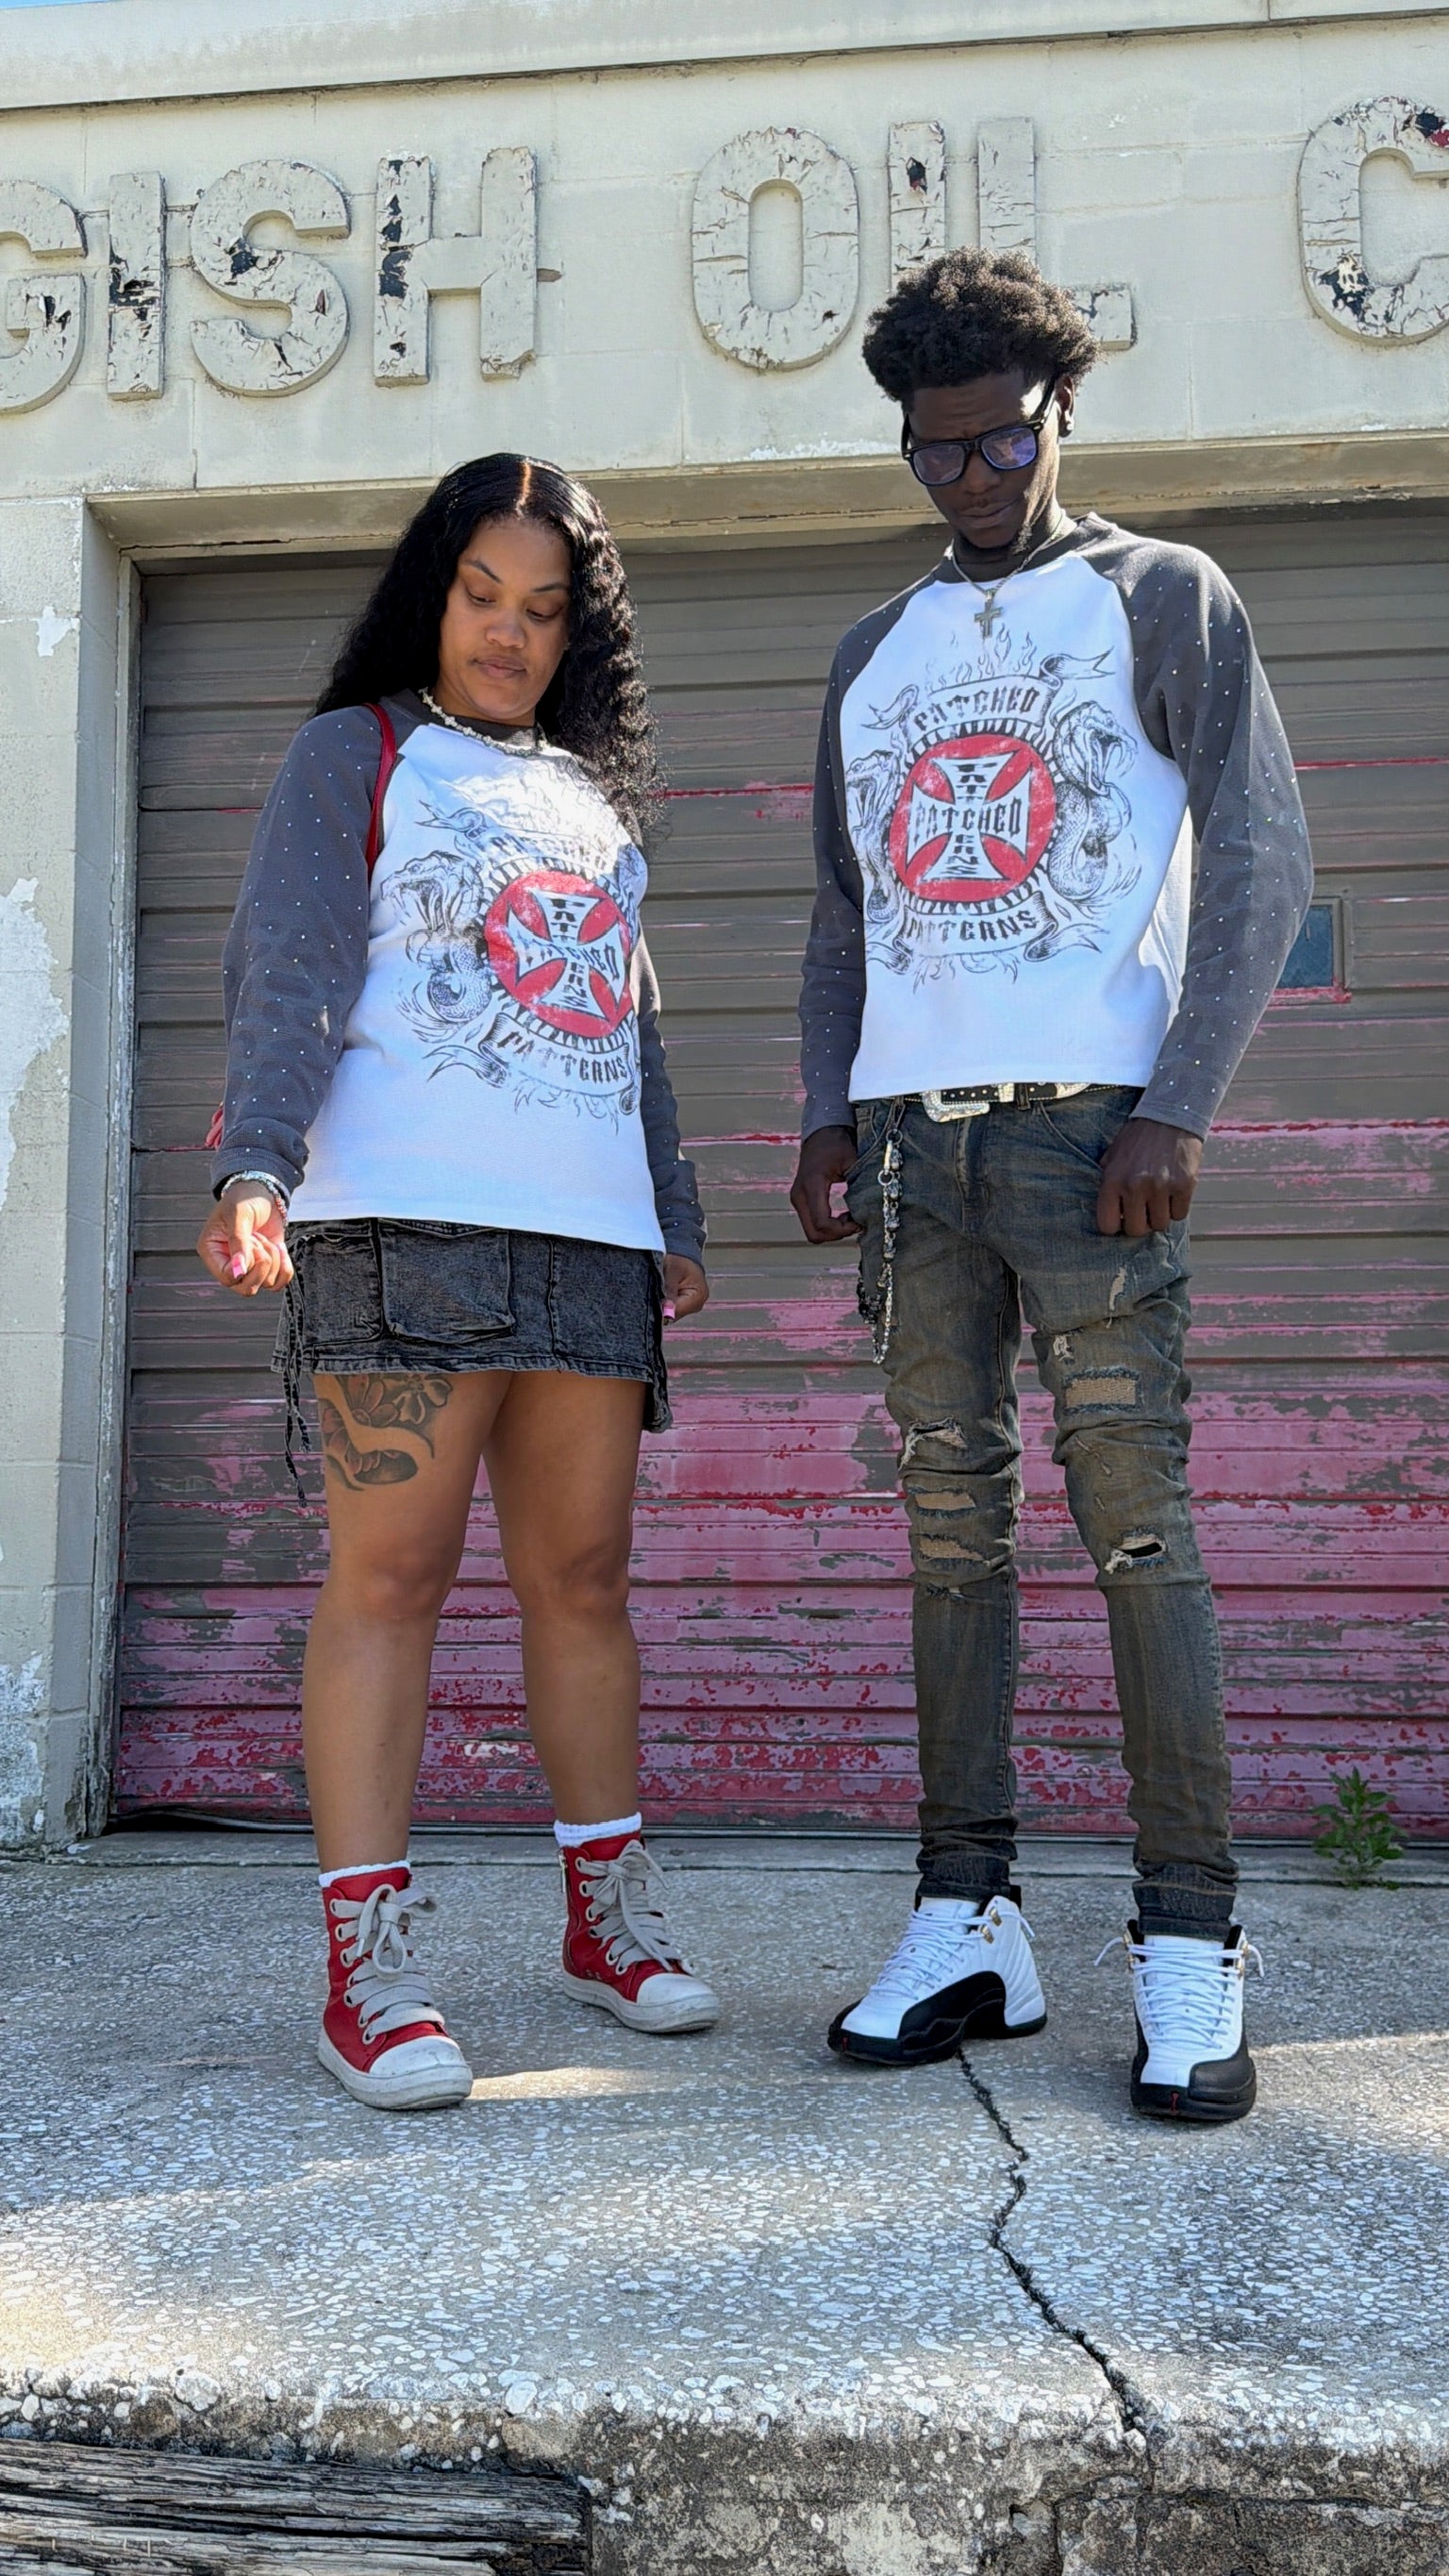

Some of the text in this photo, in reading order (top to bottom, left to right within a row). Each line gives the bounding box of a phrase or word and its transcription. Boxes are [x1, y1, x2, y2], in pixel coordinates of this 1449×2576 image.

[912, 685, 1041, 732] PATCHED
[913, 795, 1024, 847] PATCHED
[906, 909, 1040, 944] PATTERNS
[496, 1030, 629, 1084] PATTERNS
